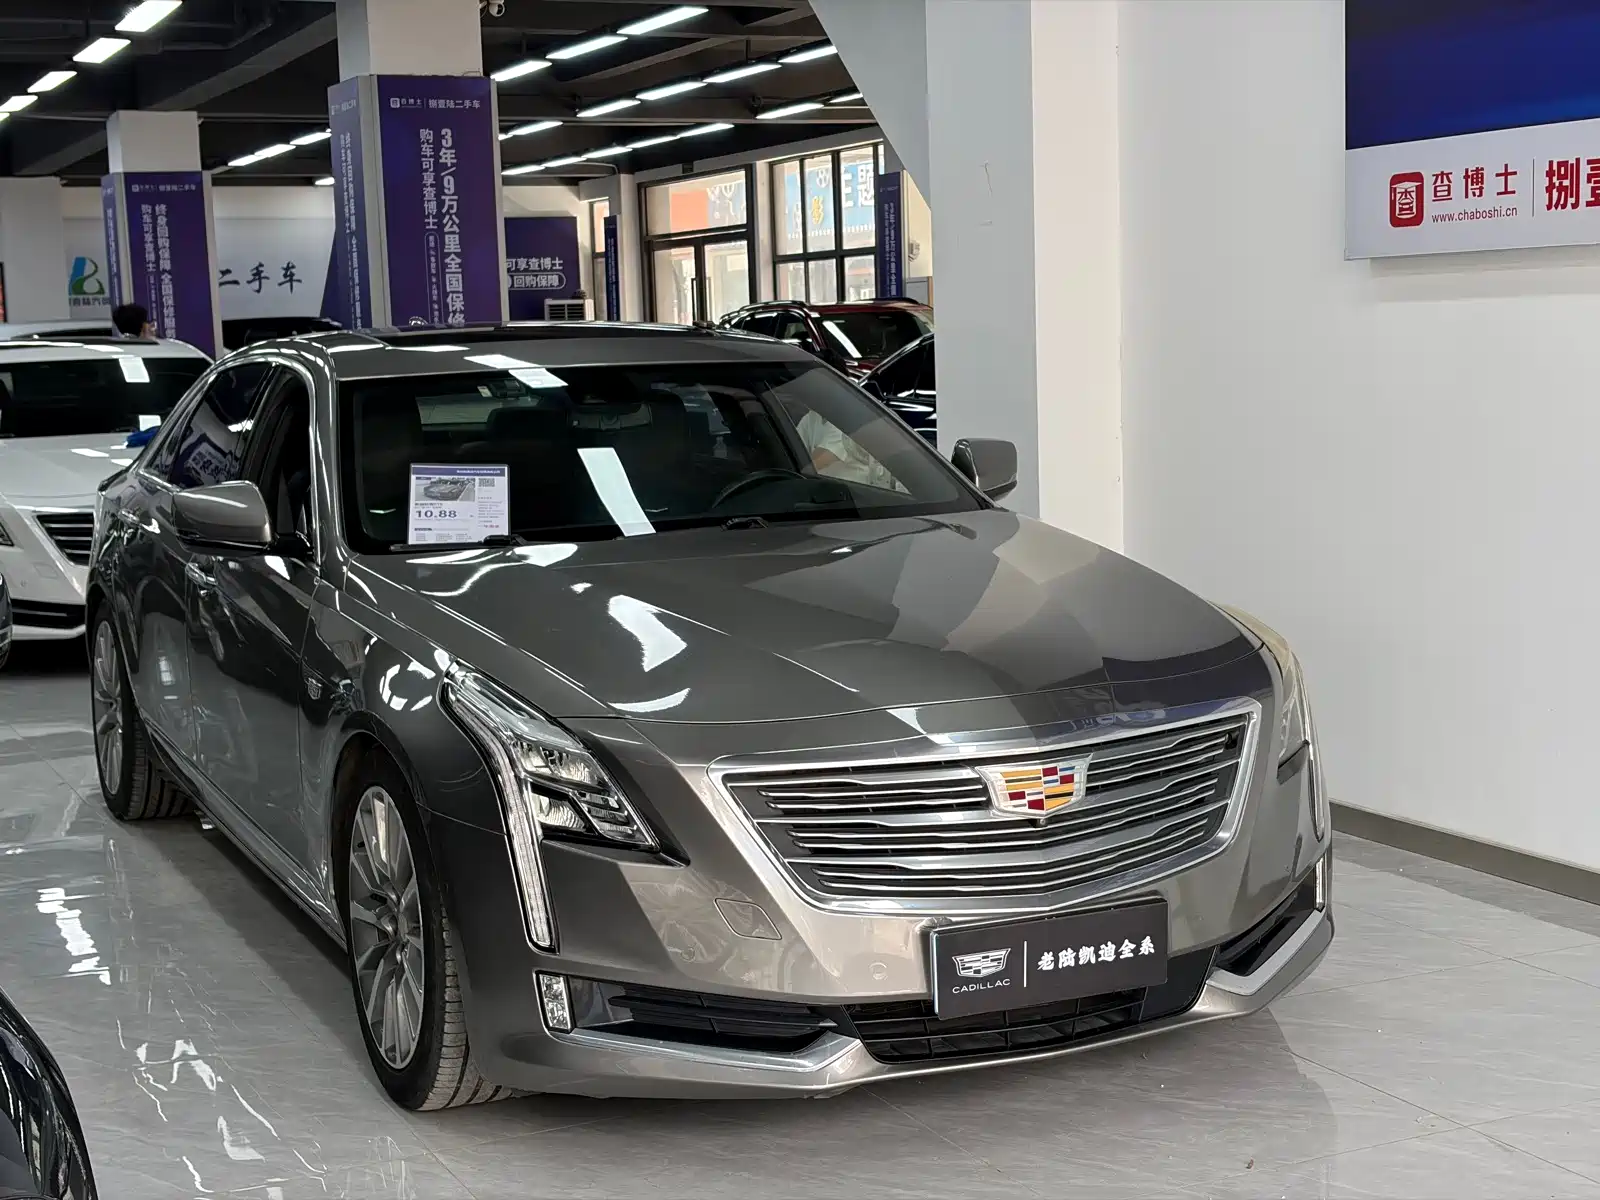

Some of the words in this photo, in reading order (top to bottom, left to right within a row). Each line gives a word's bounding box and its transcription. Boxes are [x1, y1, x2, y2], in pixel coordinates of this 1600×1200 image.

[420, 128, 438, 229] 购车可享查博士
[1432, 163, 1518, 202] 查博士
[1432, 205, 1518, 223] www.chaboshi.cn
[506, 256, 563, 271] 可享查博士
[218, 261, 302, 294] 二手车
[513, 275, 559, 288] 回购保障
[415, 510, 457, 518] 10.88
[1037, 935, 1155, 971] 老陆凯迪全系
[952, 978, 1011, 994] CADILLAC
